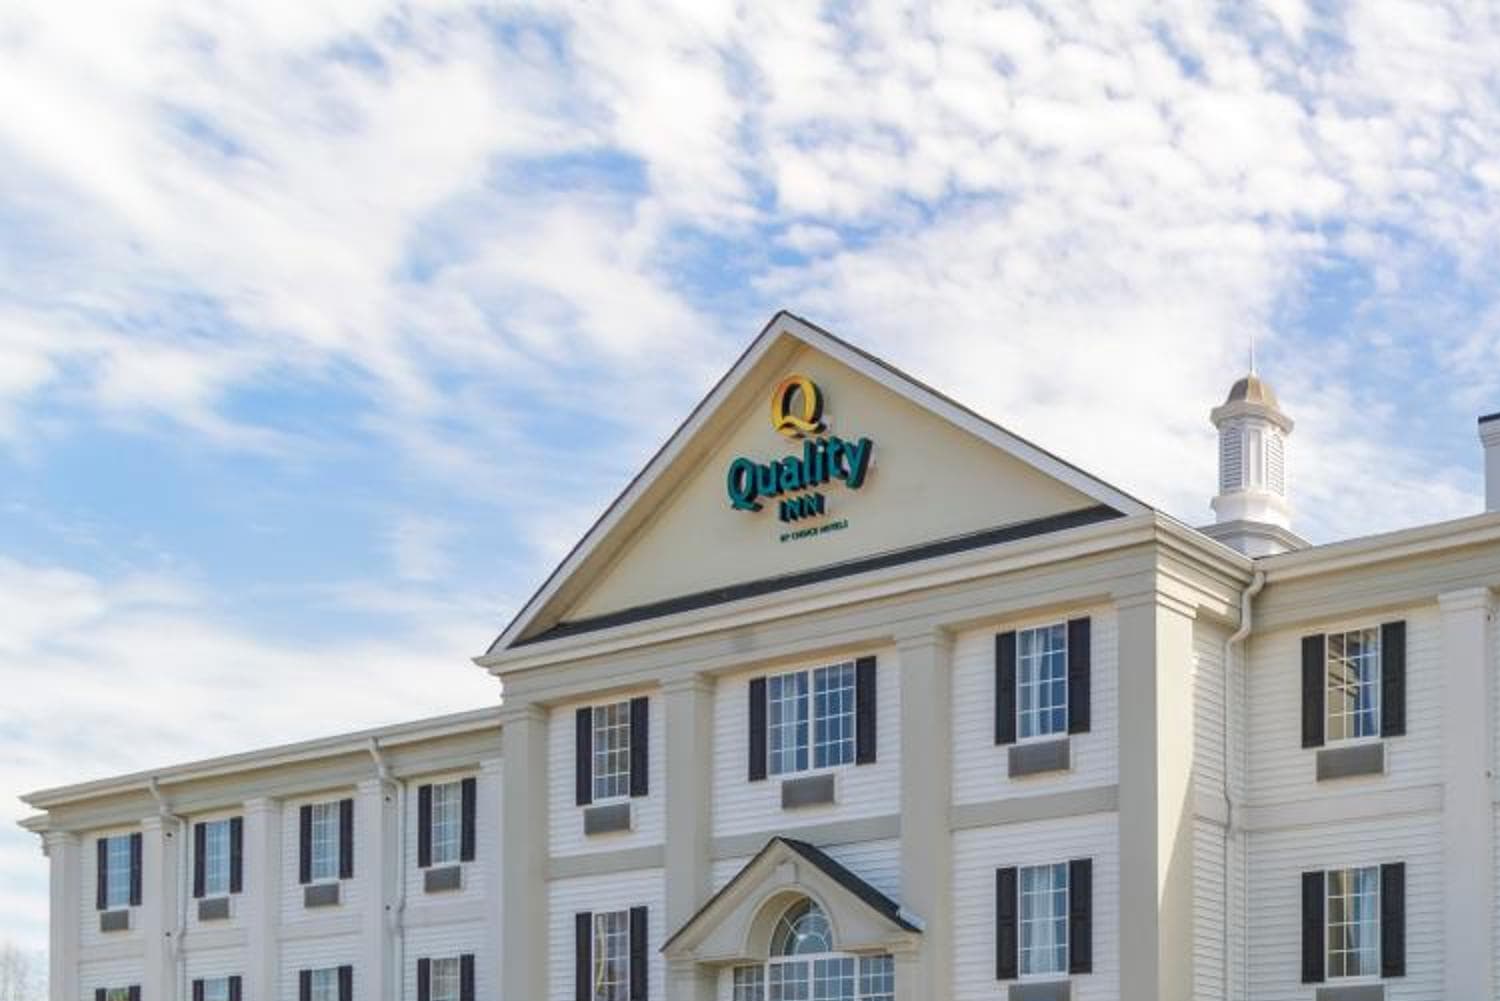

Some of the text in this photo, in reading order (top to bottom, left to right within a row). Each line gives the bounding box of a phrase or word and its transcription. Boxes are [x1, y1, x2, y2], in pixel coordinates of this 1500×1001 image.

[772, 374, 825, 437] Q
[727, 436, 873, 511] Quality
[780, 492, 825, 522] INN
